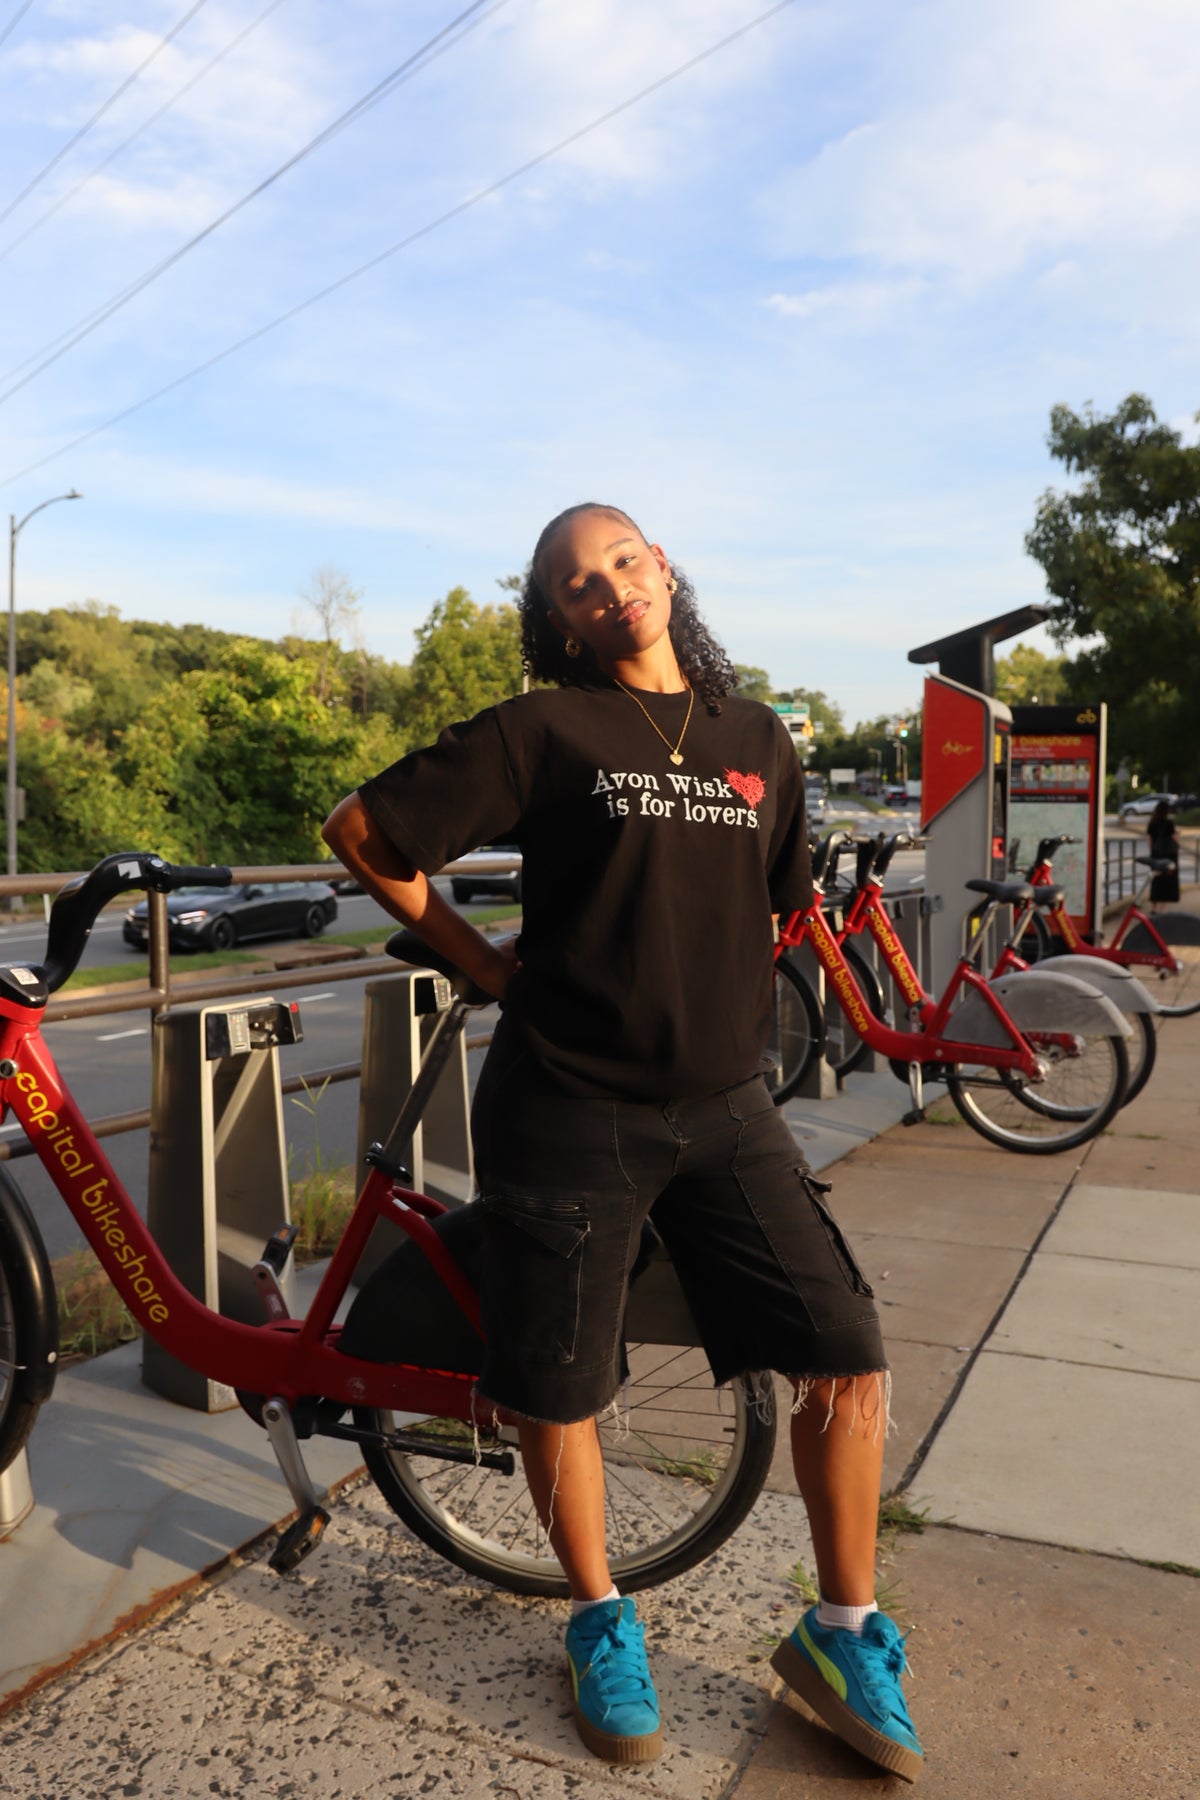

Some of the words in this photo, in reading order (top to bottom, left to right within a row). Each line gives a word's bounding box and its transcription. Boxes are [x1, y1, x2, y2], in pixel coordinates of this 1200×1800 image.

[591, 769, 660, 795] Avon
[666, 773, 733, 799] Wisk
[606, 794, 631, 818] is
[640, 792, 676, 818] for
[870, 911, 899, 954] capital
[810, 921, 840, 969] capital
[833, 967, 869, 1033] bikeshare
[16, 1072, 94, 1178] capital
[82, 1177, 169, 1323] bikeshare
